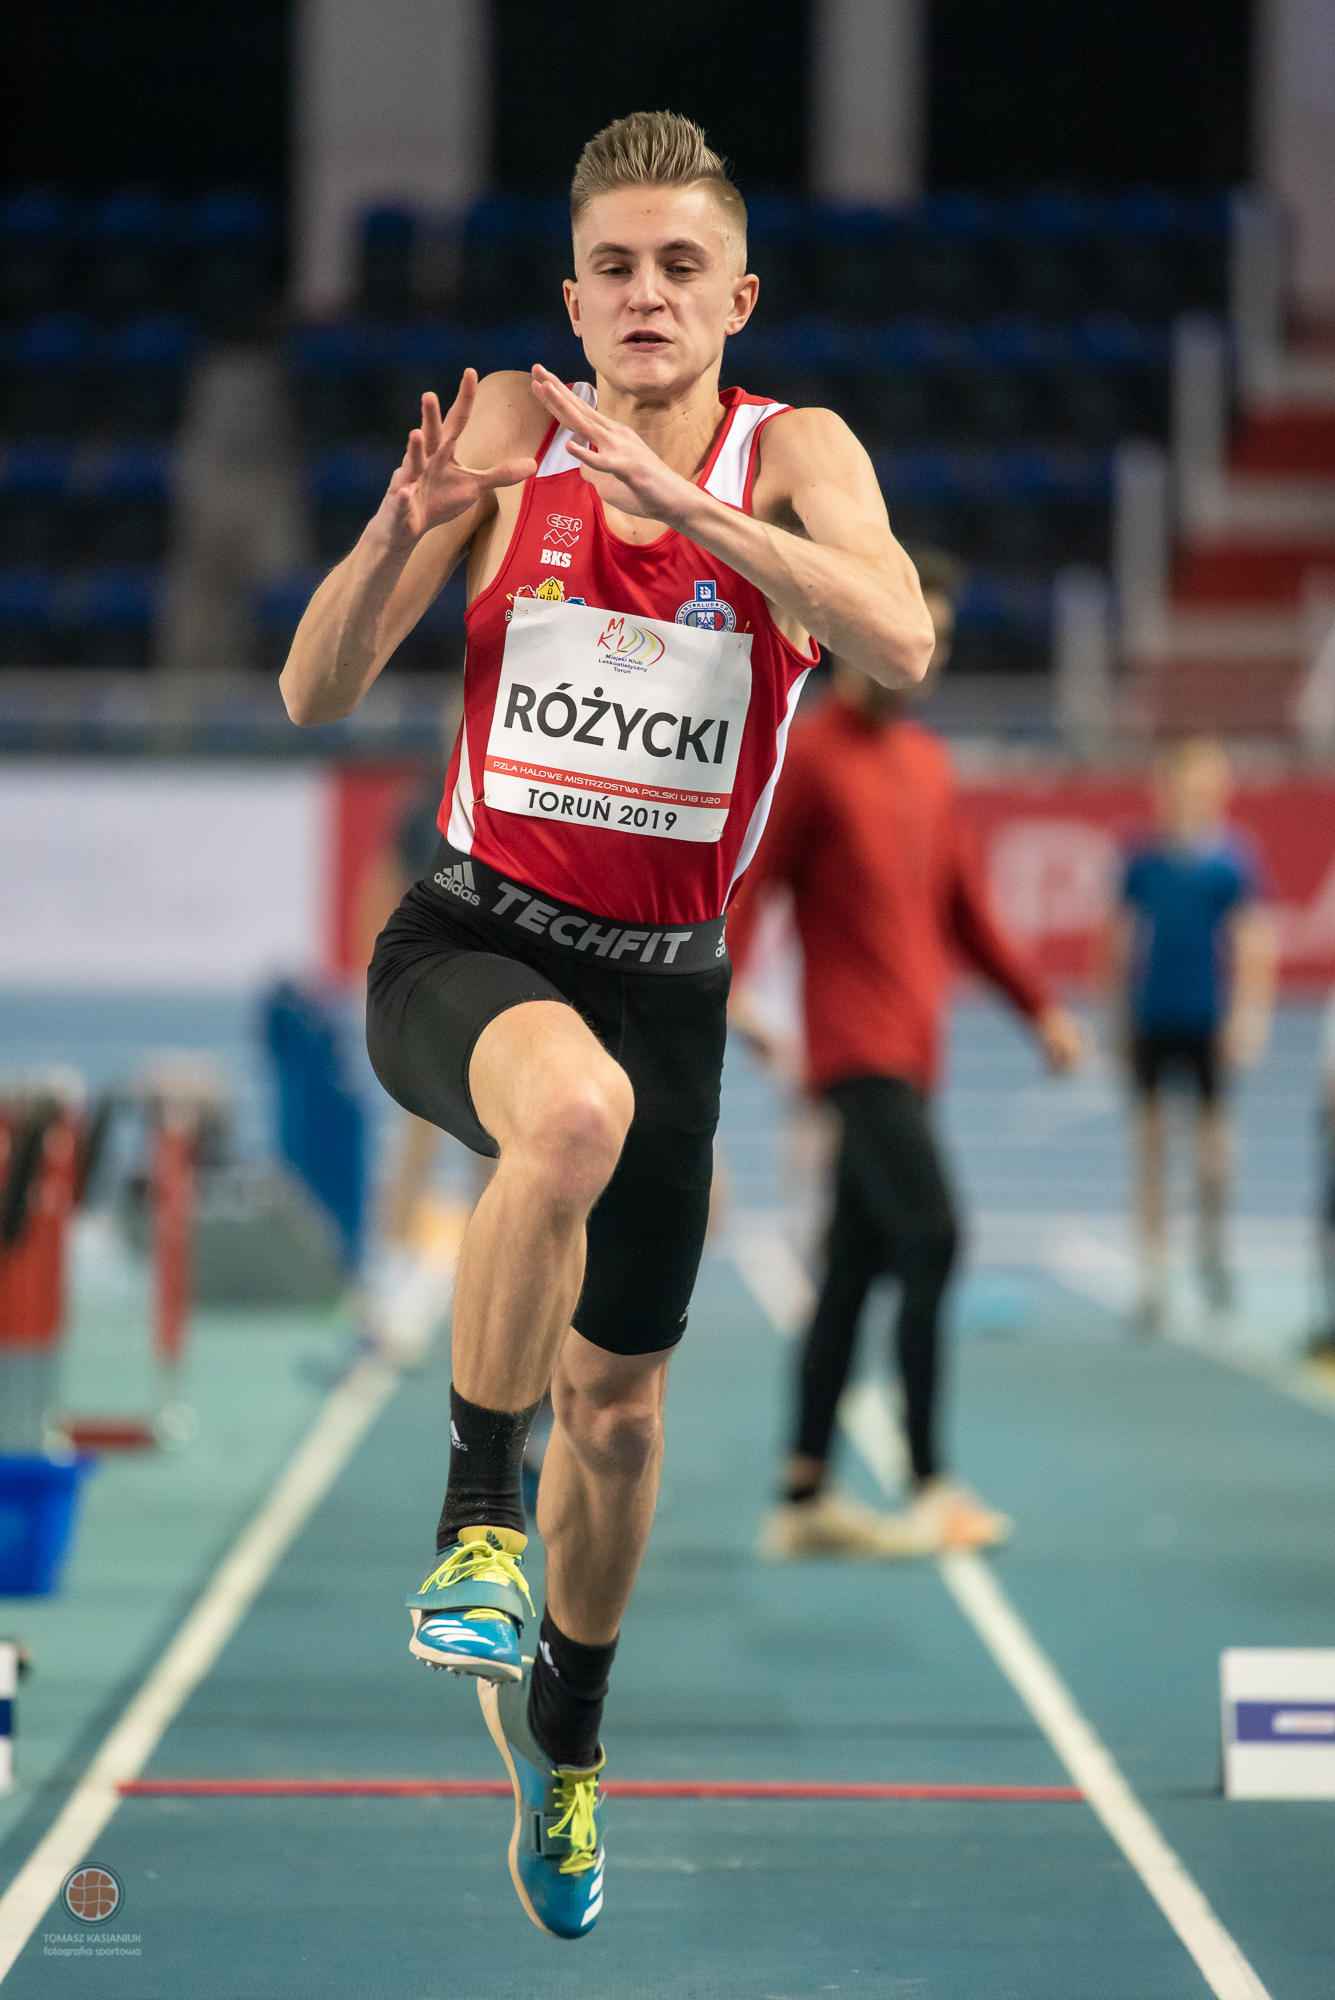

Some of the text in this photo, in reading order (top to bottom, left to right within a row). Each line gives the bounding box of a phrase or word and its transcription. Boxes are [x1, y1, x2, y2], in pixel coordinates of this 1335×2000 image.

[541, 549, 572, 568] BKS
[598, 658, 648, 673] Lekkoatletyczny
[605, 653, 643, 666] Miejski Klub
[613, 666, 631, 674] Toruń
[504, 683, 729, 764] RÓŻYCKI
[493, 761, 721, 804] PZLA HALOWE MISTRZOSTWA POLSKI U18 U20
[528, 788, 677, 831] TORUŃ 2019
[433, 871, 481, 906] adidas
[491, 881, 693, 964] TECHFIT
